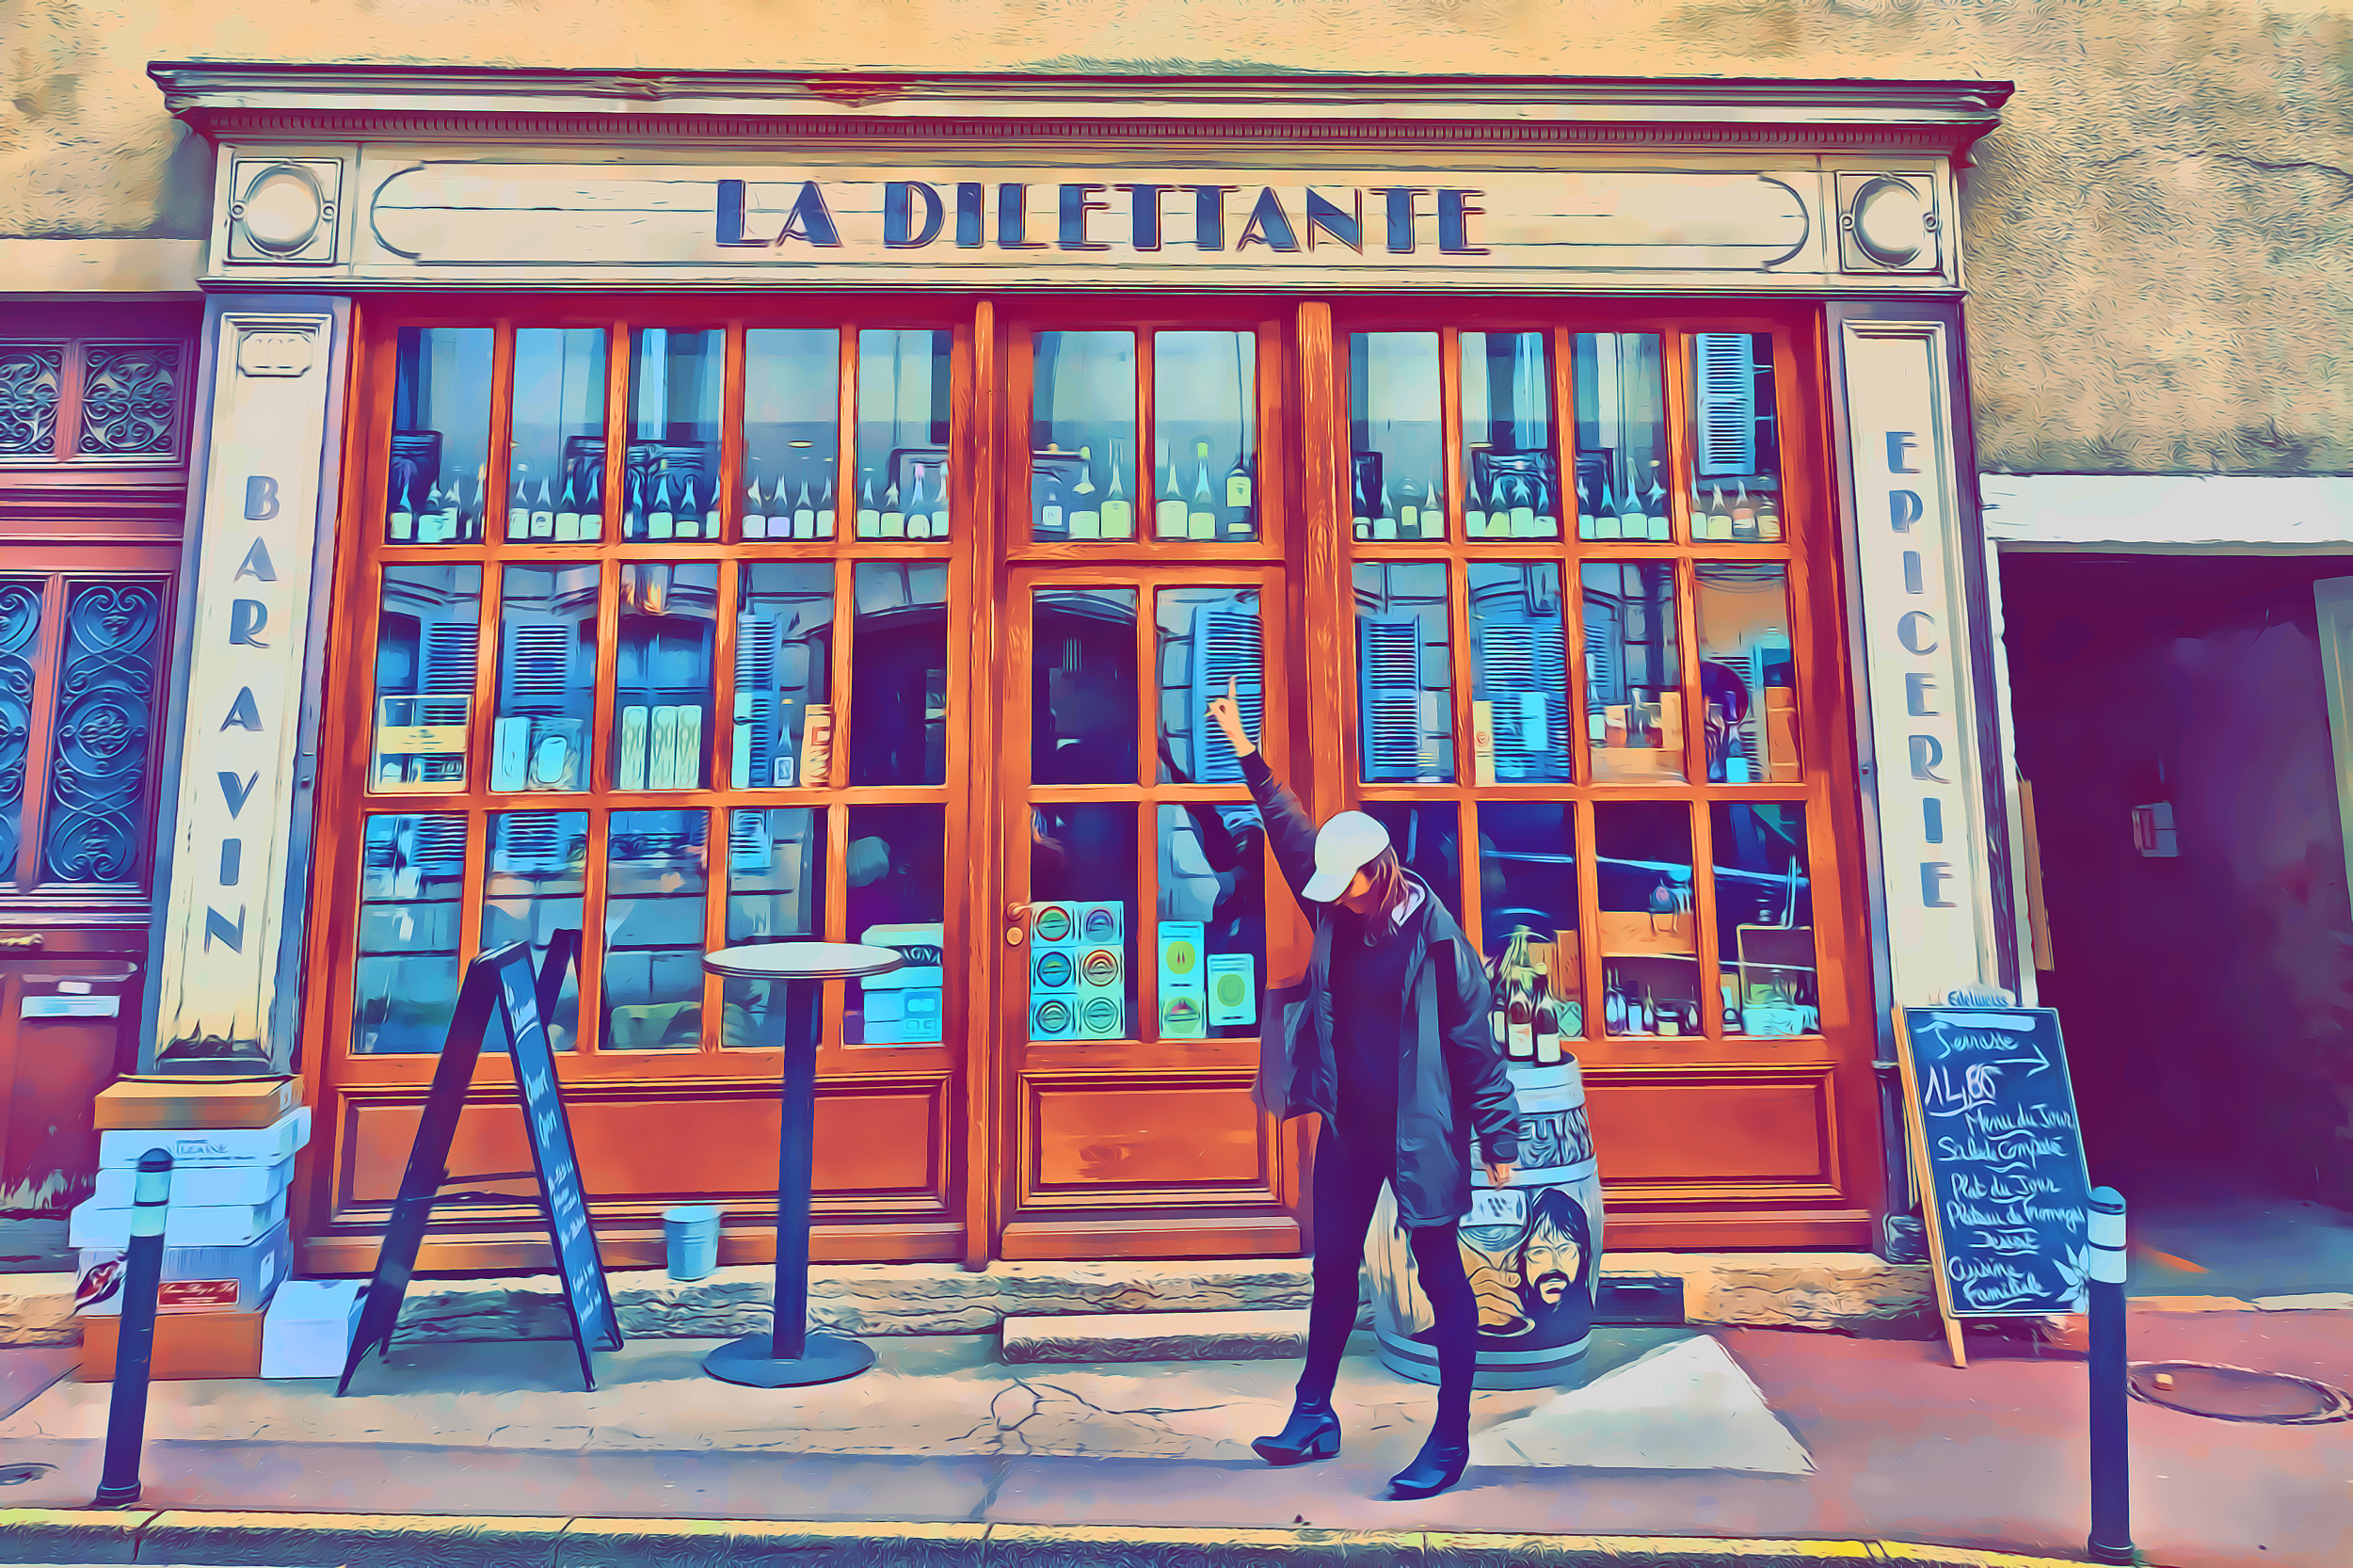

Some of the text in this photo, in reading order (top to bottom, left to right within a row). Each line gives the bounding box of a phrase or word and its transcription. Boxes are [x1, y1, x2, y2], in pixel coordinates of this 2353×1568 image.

[716, 180, 1492, 255] LA DILETTANTE
[1884, 430, 1958, 908] EPICERIE
[203, 474, 280, 955] BAR A VIN
[1964, 1101, 2073, 1137] Menu du Jour
[1950, 1172, 2062, 1204] Plat du Jour
